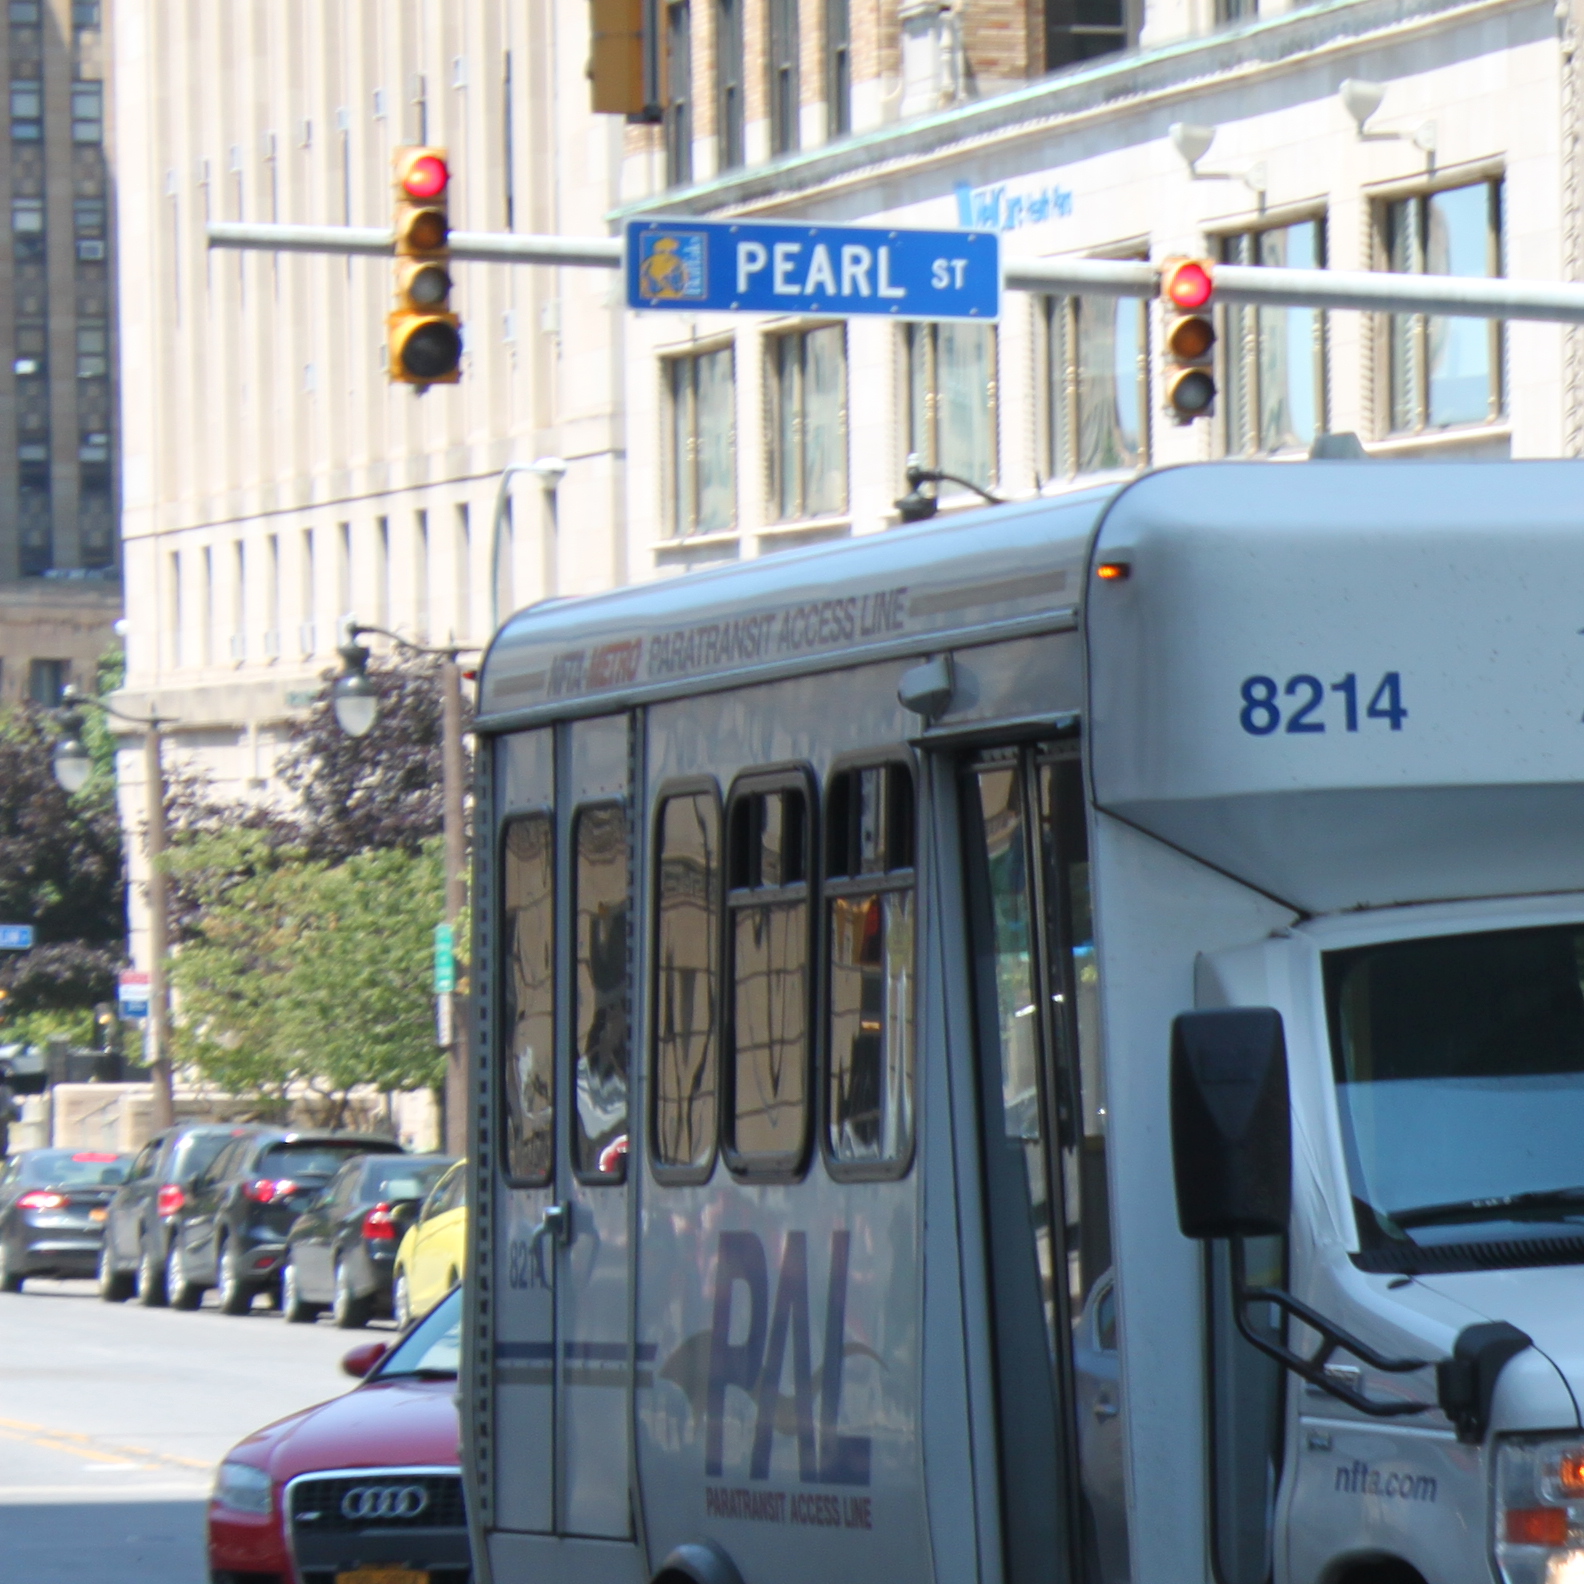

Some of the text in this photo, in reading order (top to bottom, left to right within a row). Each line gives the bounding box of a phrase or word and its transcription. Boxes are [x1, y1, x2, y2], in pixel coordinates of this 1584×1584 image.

[735, 240, 907, 299] PEARL
[930, 257, 968, 290] ST
[647, 612, 777, 677] PARATRANSIT
[777, 596, 857, 652] ACCESS
[860, 585, 908, 637] LINE
[1239, 670, 1409, 736] 8214
[705, 1230, 872, 1487] PAL
[705, 1486, 873, 1531] PARATRANSIT ACCESS LINE
[1334, 1459, 1438, 1502] nfta.com
